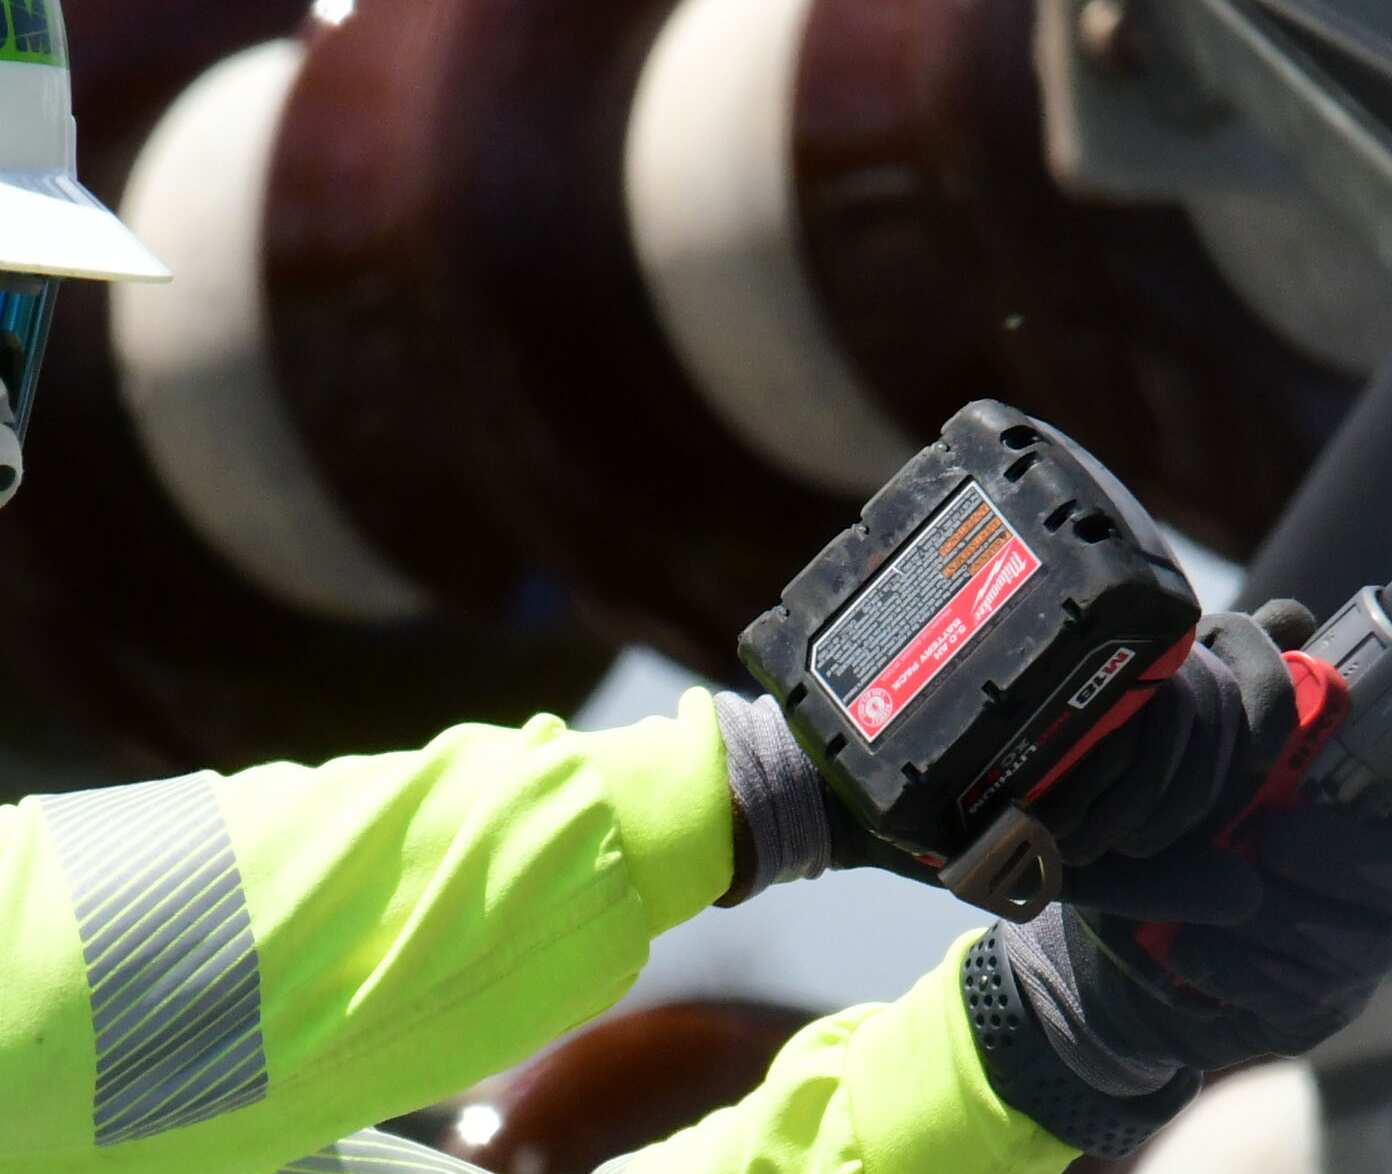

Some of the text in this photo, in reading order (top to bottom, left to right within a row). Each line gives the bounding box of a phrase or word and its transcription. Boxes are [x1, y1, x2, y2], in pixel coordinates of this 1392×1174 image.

[971, 552, 1028, 621] Milwaukee
[917, 616, 962, 662] BATTERY
[890, 660, 920, 691] PACK
[1074, 650, 1128, 704] M18
